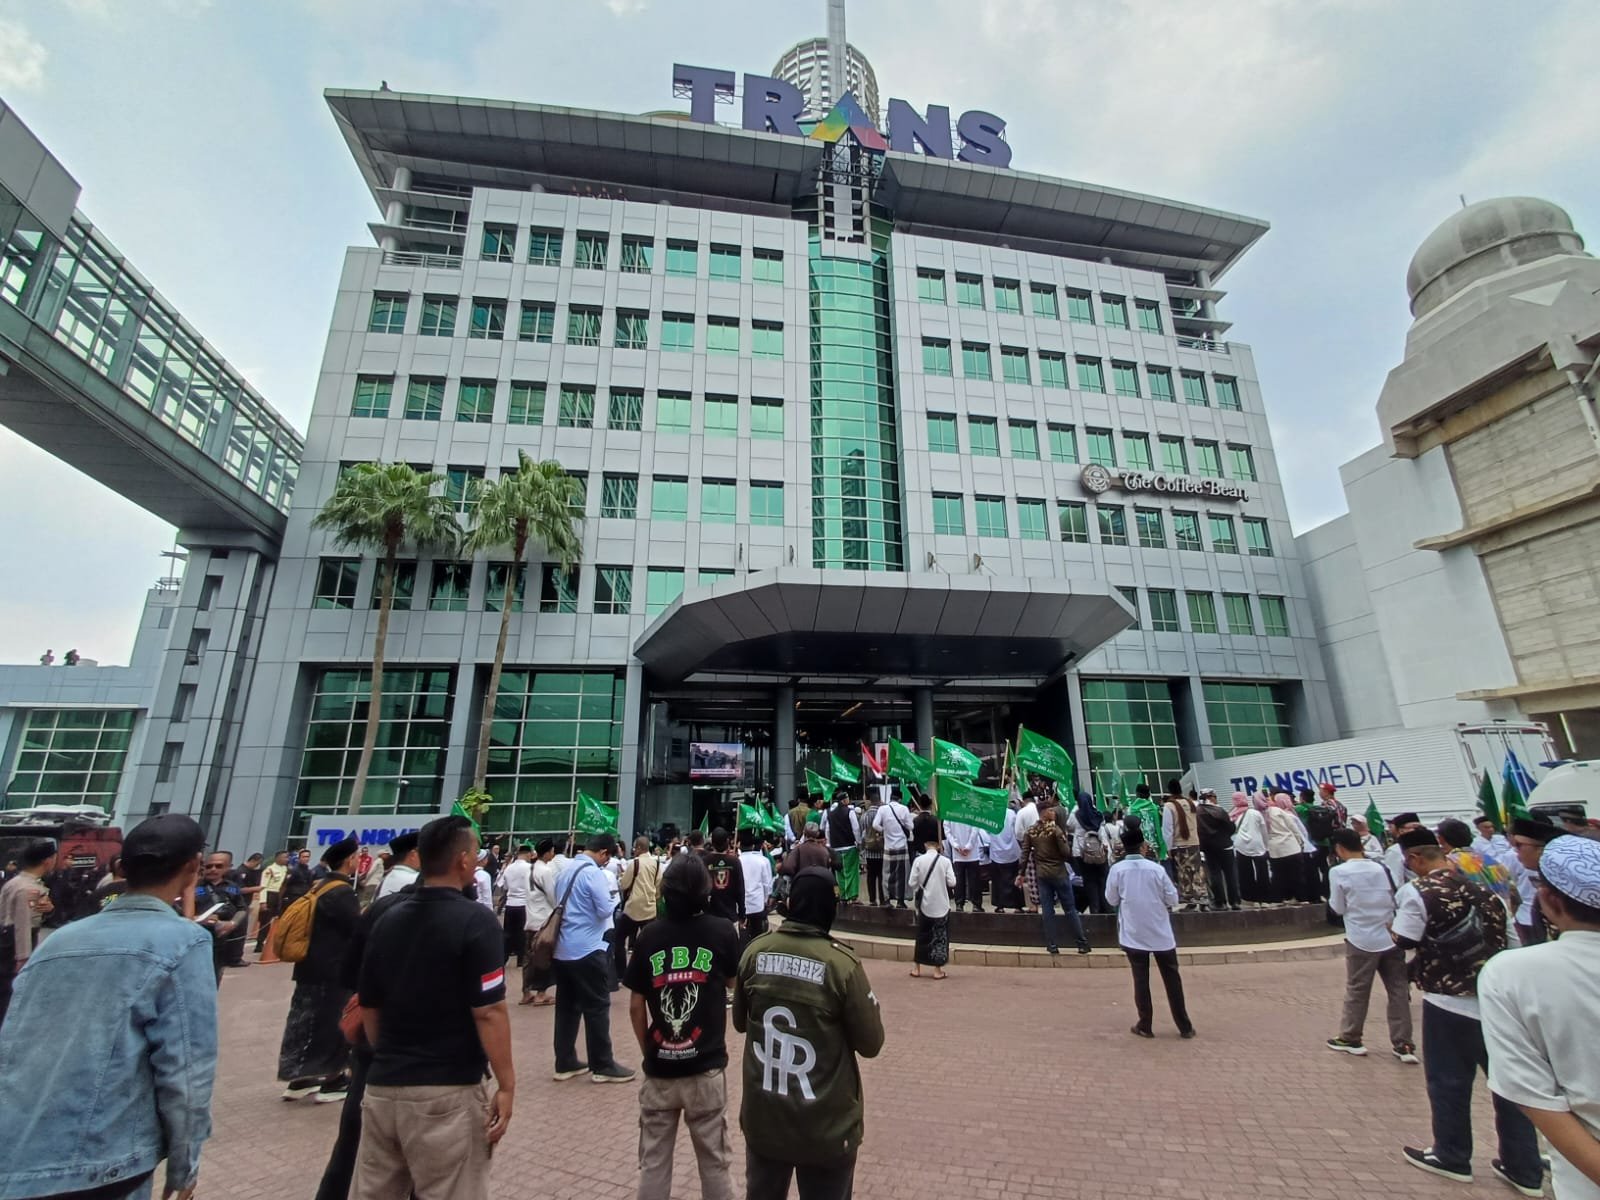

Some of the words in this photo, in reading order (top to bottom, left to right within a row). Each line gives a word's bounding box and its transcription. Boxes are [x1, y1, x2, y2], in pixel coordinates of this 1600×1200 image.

[673, 63, 1012, 169] TRANS
[1118, 471, 1151, 490] The
[1153, 475, 1203, 494] Coffee
[1203, 479, 1249, 502] Bean
[649, 946, 713, 976] FBR
